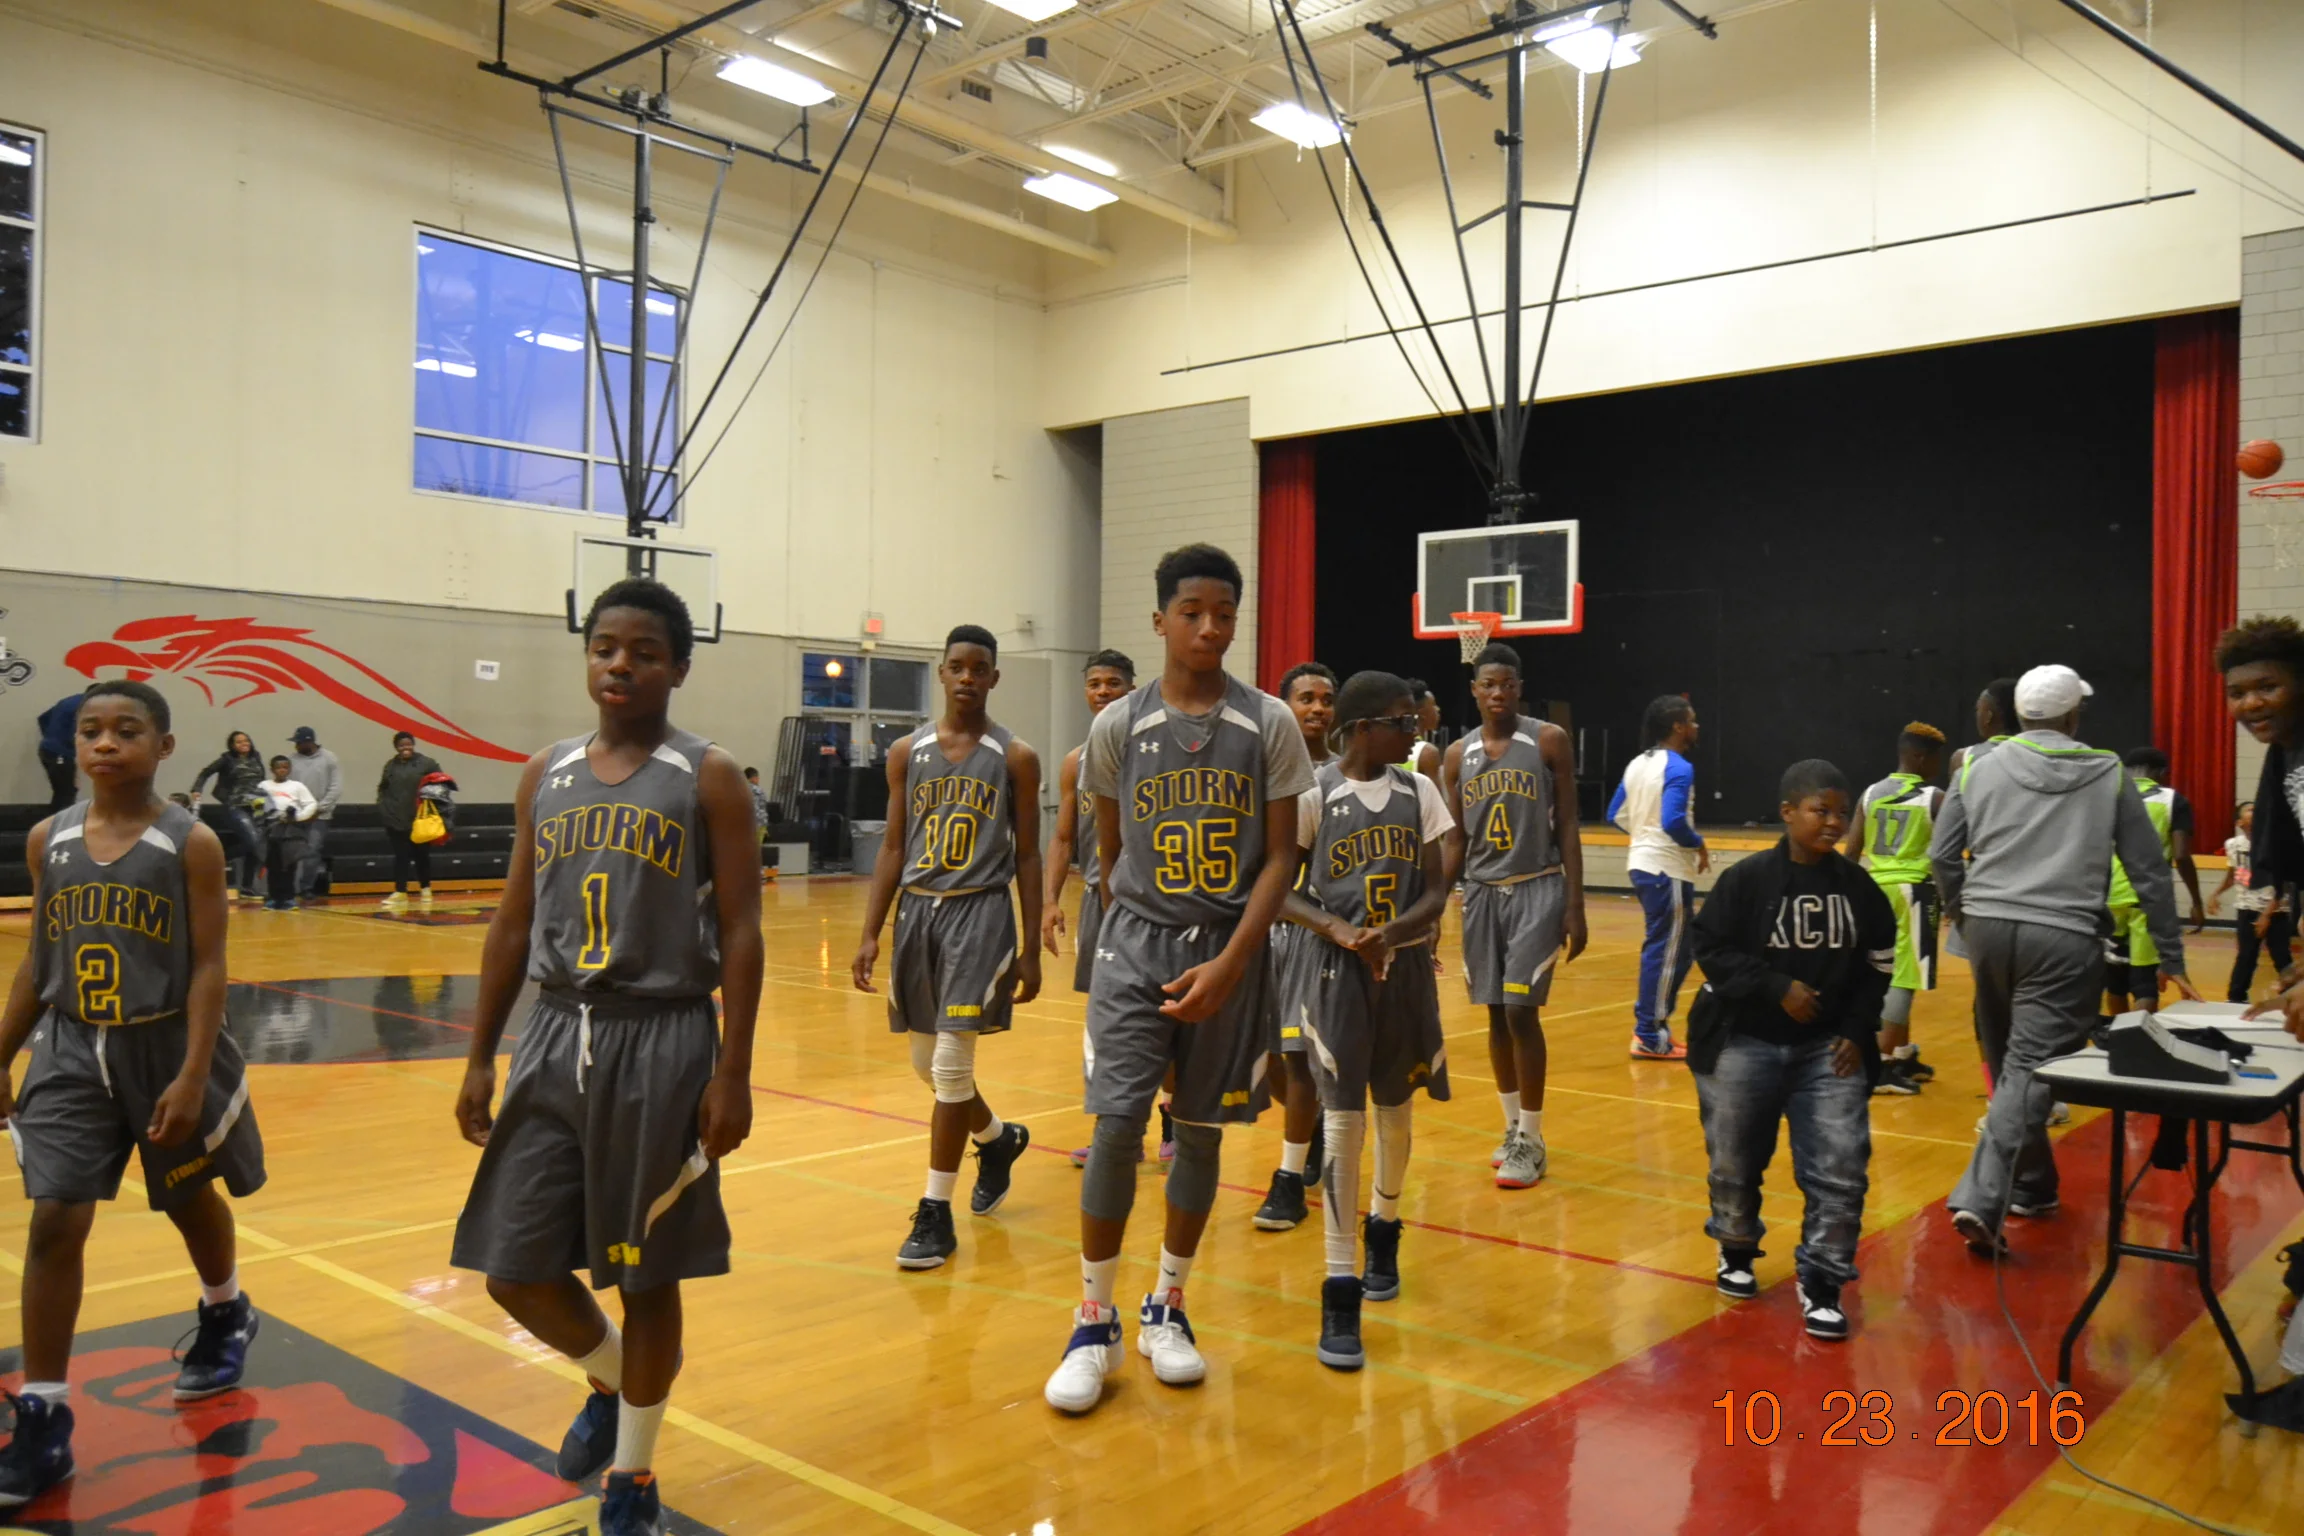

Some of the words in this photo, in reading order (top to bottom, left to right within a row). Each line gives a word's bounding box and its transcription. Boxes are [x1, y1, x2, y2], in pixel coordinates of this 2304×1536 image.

[913, 775, 999, 819] STORM
[1132, 767, 1254, 821] STORM
[1462, 768, 1537, 808] STORM
[535, 803, 685, 877] STORM
[916, 813, 977, 870] 10
[1486, 803, 1513, 850] 4
[1872, 807, 1911, 856] 17
[1153, 818, 1237, 893] 35
[47, 882, 173, 943] STORM
[577, 873, 611, 969] 1
[1364, 873, 1397, 928] 5
[76, 943, 124, 1025] 2
